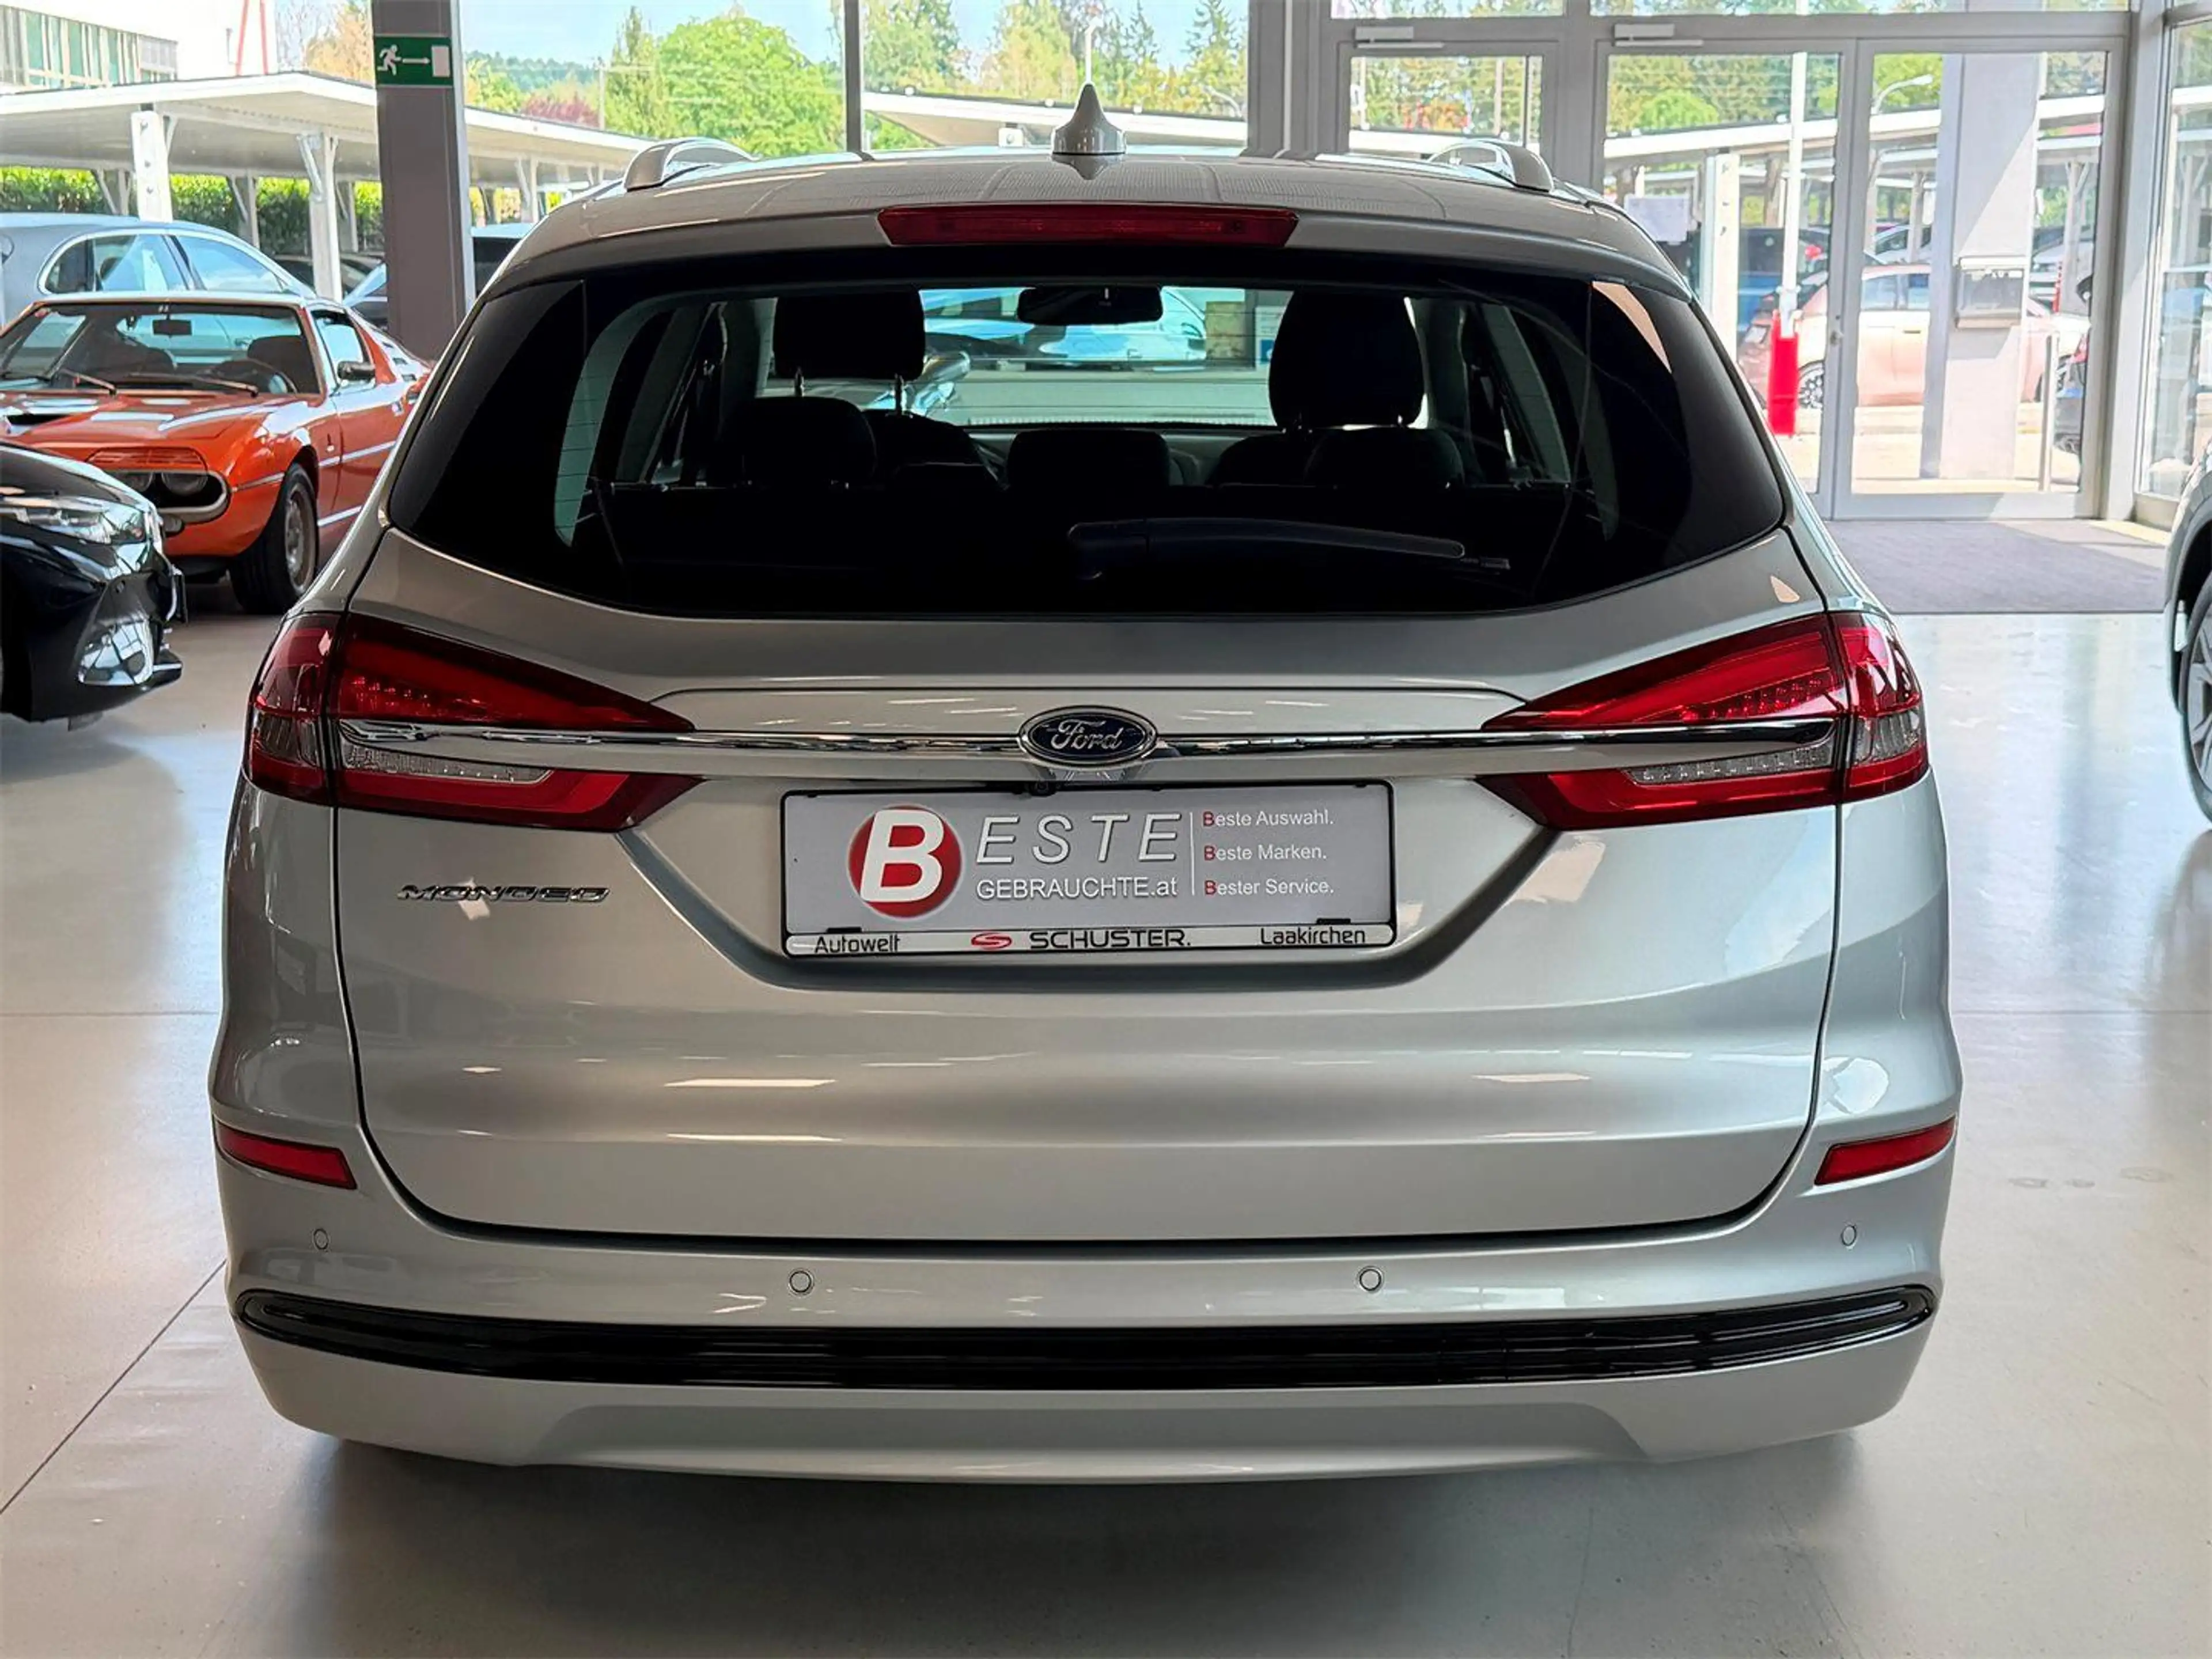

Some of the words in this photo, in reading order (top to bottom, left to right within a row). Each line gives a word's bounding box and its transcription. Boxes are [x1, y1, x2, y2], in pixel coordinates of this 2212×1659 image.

[1051, 719, 1124, 749] Ford
[1203, 810, 1252, 827] Beste
[1256, 809, 1334, 825] Auswahl.
[1204, 845, 1253, 861] Beste
[1257, 844, 1327, 860] Marken.
[397, 884, 611, 903] MONDEO
[976, 877, 1177, 900] GEBRAUCHTE.at
[1205, 880, 1260, 895] Bester
[1266, 878, 1334, 895] Service.
[814, 934, 900, 953] Autowelt
[1029, 929, 1192, 949] SCHUSTER.
[1260, 926, 1366, 945] Laakirchen
